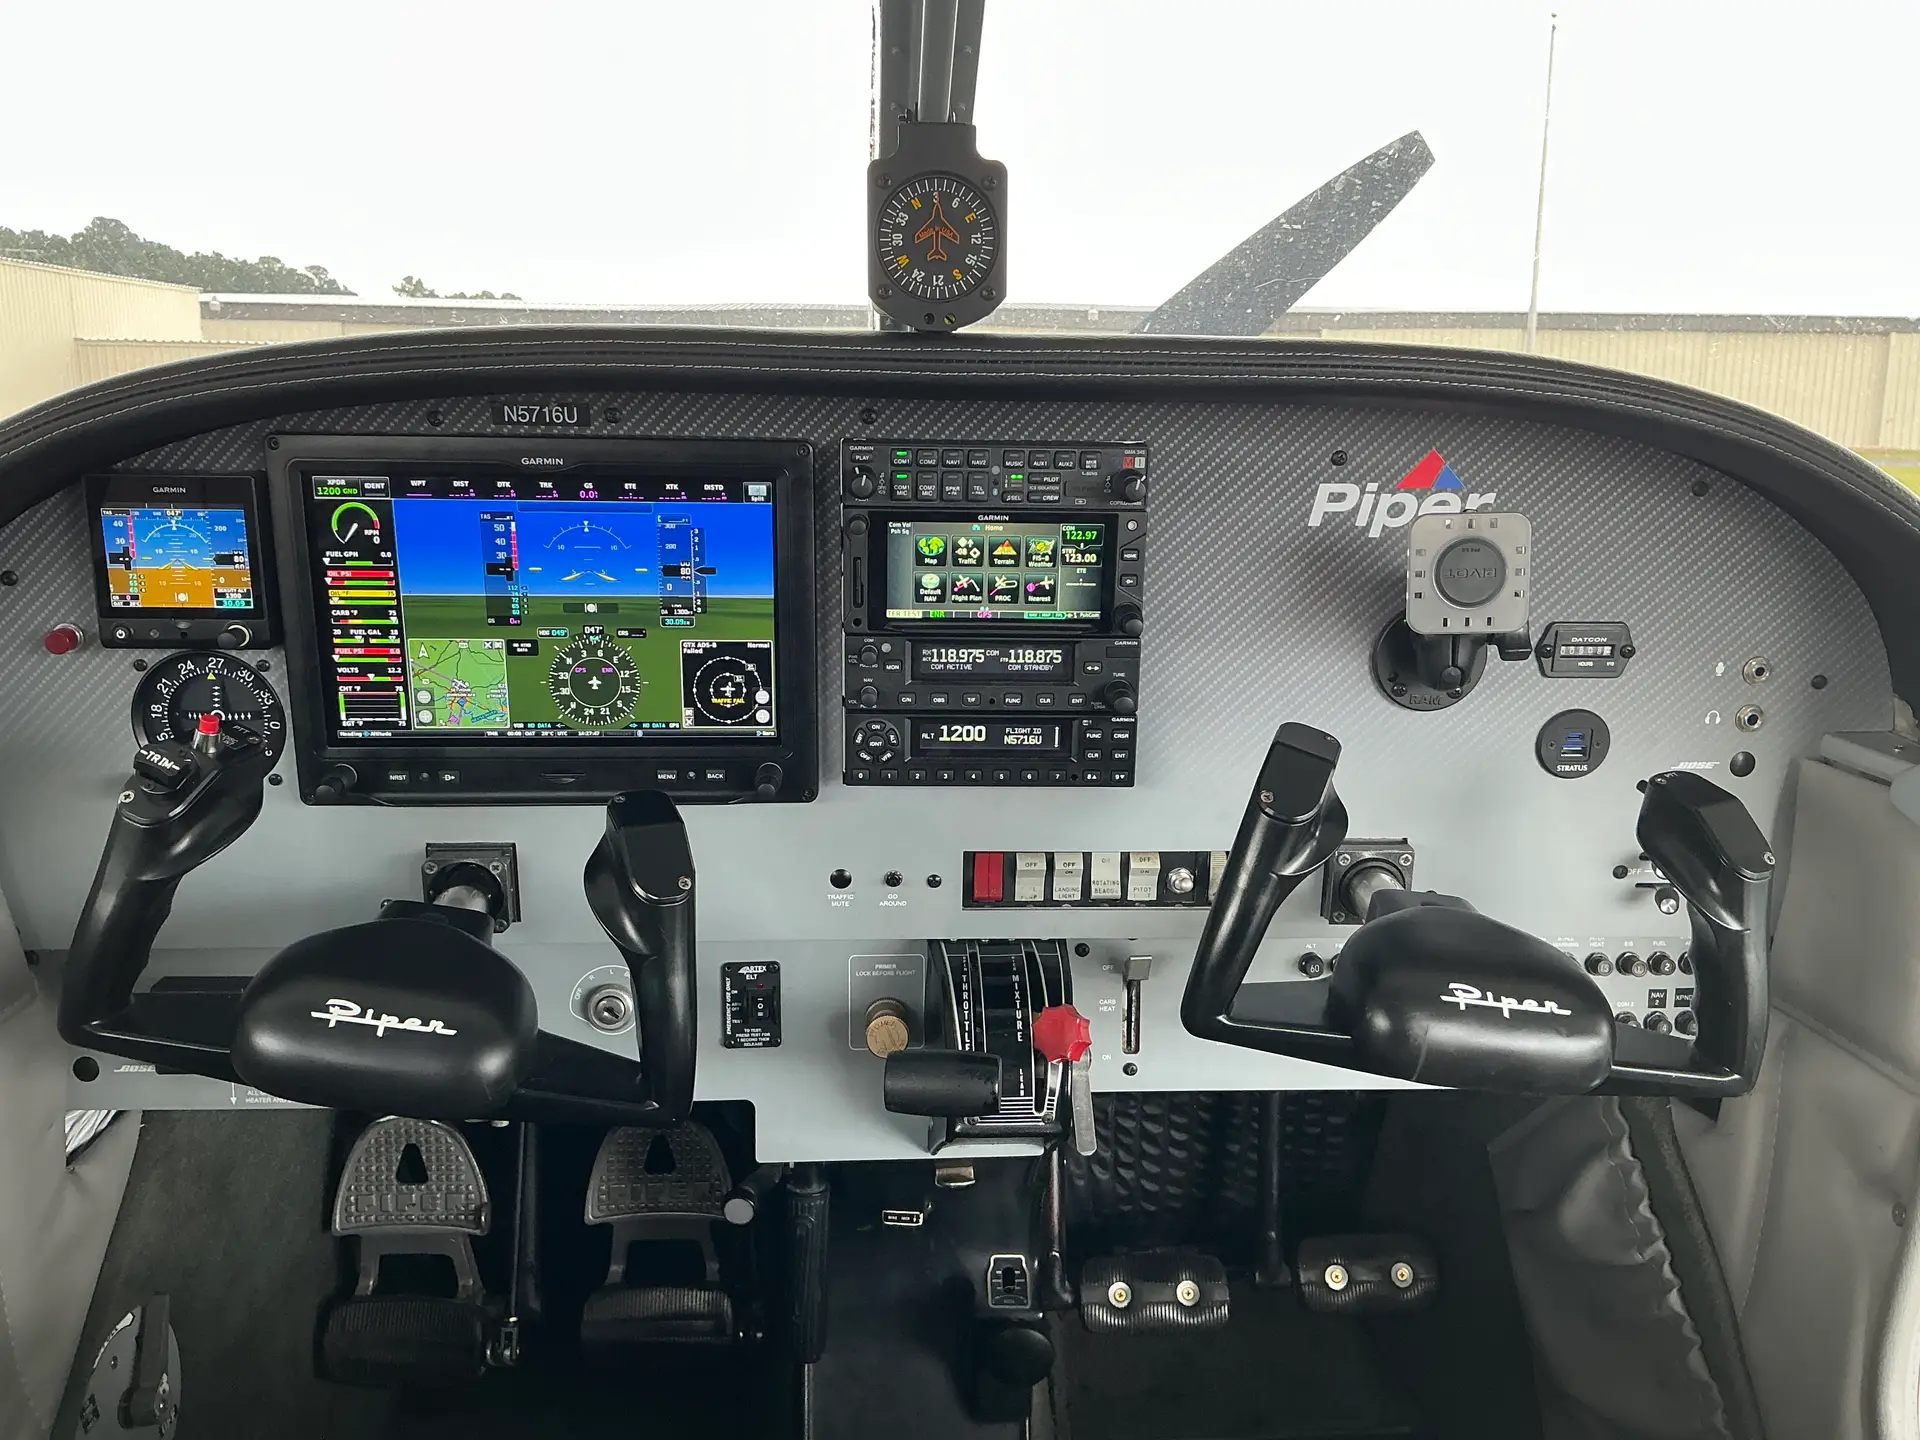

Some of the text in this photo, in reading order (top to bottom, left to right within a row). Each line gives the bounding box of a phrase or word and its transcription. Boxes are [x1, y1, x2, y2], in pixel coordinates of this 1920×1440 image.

[896, 212, 909, 226] 33
[892, 233, 903, 247] 30
[970, 232, 982, 244] 12
[965, 253, 978, 266] 15
[911, 268, 925, 282] 24
[933, 275, 944, 286] 21
[503, 405, 578, 423] N5716U
[521, 457, 564, 465] GARMIN
[317, 487, 341, 495] 1200
[1307, 482, 1497, 538] Piper
[493, 524, 504, 532] 50
[1066, 531, 1097, 540] 122.97
[1065, 553, 1097, 563] 123.00
[931, 648, 985, 662] 118.975
[1008, 649, 1062, 663] 118.875
[177, 660, 195, 674] 24
[207, 657, 225, 669] 27
[237, 667, 254, 682] 30
[156, 678, 172, 694] 21
[260, 689, 275, 705] 33
[151, 704, 163, 719] 18
[938, 725, 987, 741] 1200
[1004, 735, 1042, 745] N5716U
[1557, 764, 1588, 772] STRATUS
[1671, 761, 1720, 769] BOSE
[1310, 964, 1320, 973] 60
[1012, 974, 1023, 1042] MIXTURE
[1440, 983, 1572, 1019] Piper
[310, 998, 457, 1037] Piper
[962, 974, 971, 1051] THROTTLE
